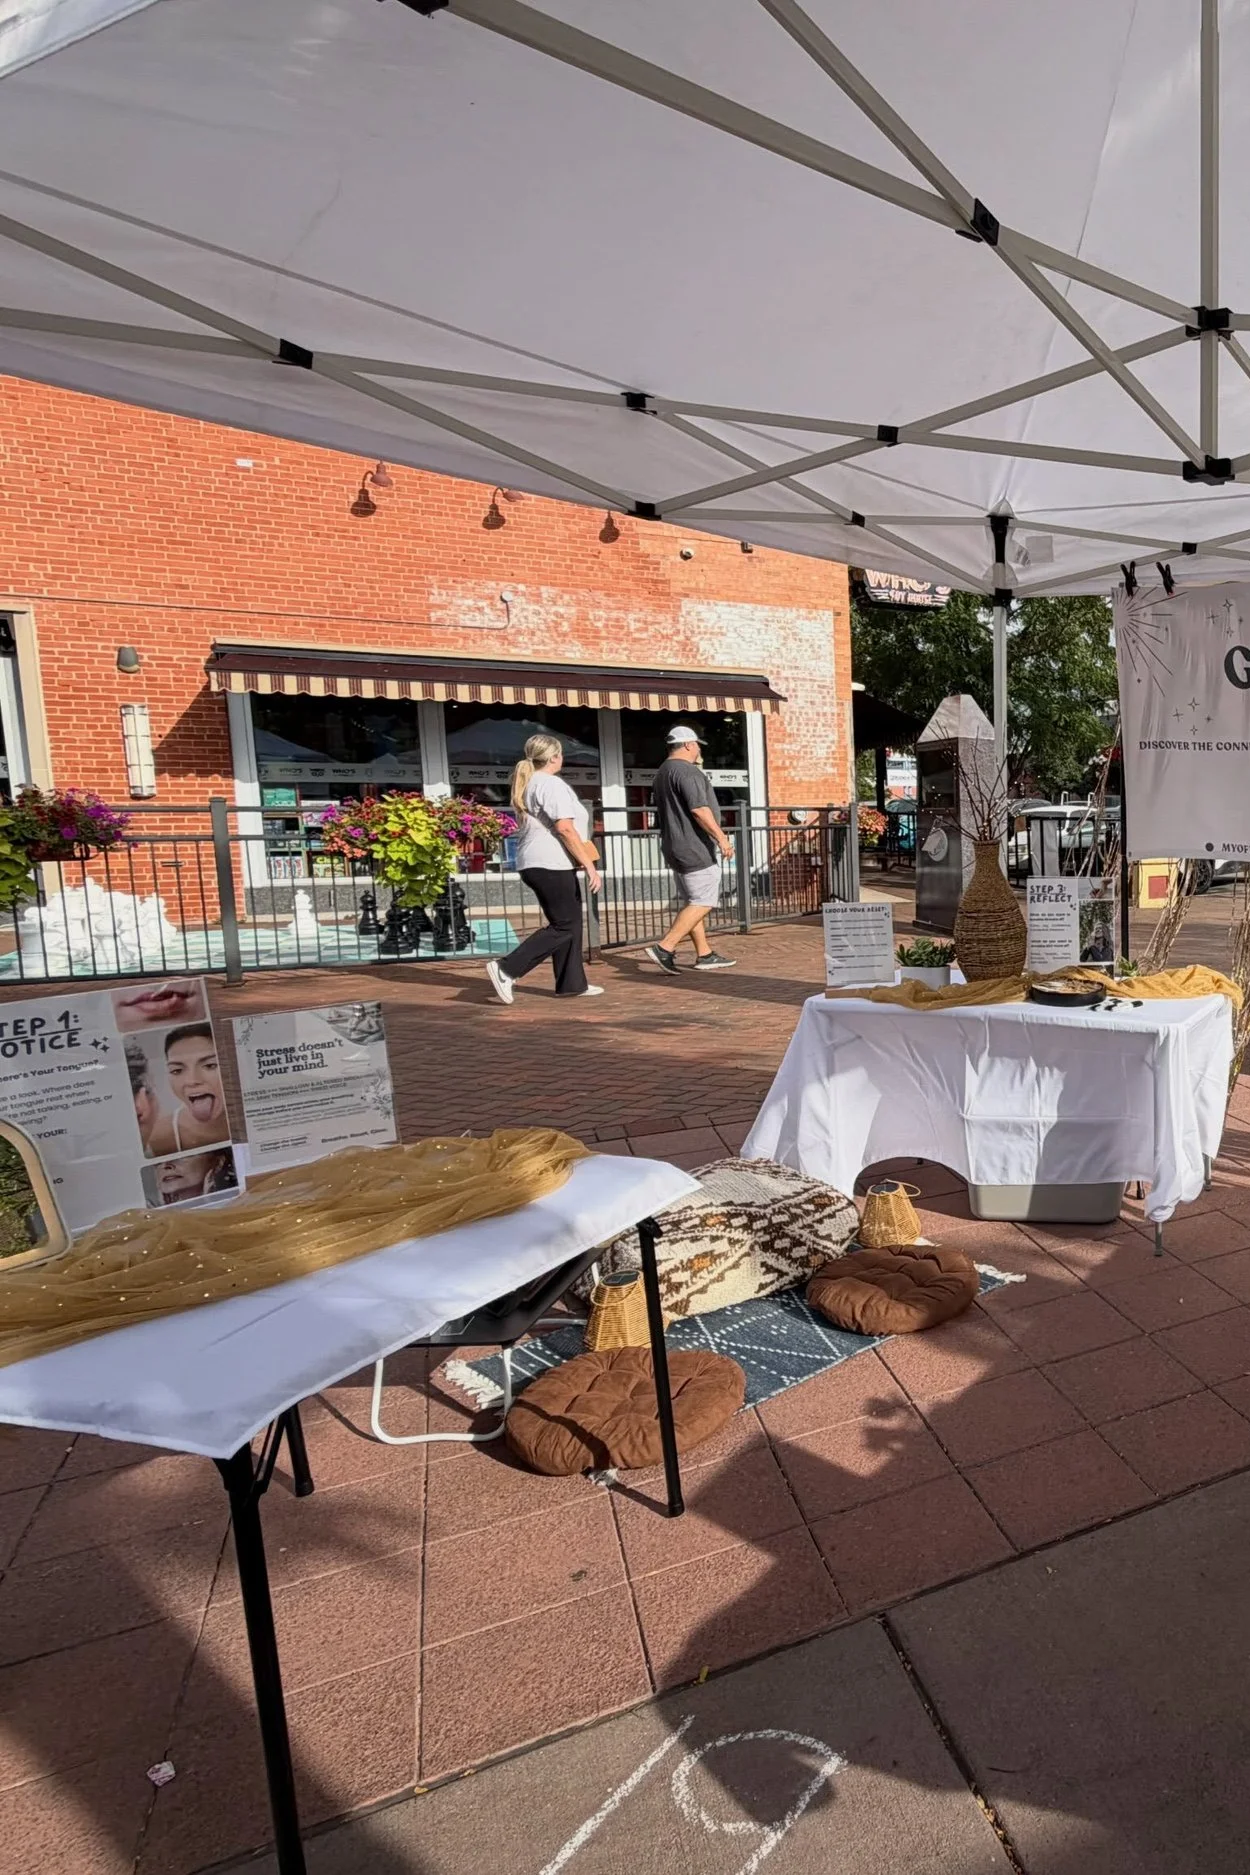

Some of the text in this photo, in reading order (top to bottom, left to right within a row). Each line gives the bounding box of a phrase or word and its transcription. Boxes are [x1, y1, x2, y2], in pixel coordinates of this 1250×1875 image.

[1139, 741, 1189, 750] DISCOVER
[1192, 742, 1213, 751] THE
[1030, 885, 1053, 894] STEP
[1030, 895, 1072, 904] REFLECT
[0, 1010, 79, 1038] TEP 1:
[0, 1032, 81, 1058] OTICE
[256, 1038, 344, 1058] Stress doesn't
[257, 1051, 324, 1070] just live in
[258, 1060, 328, 1079] your mind.
[31, 1068, 54, 1076] Your
